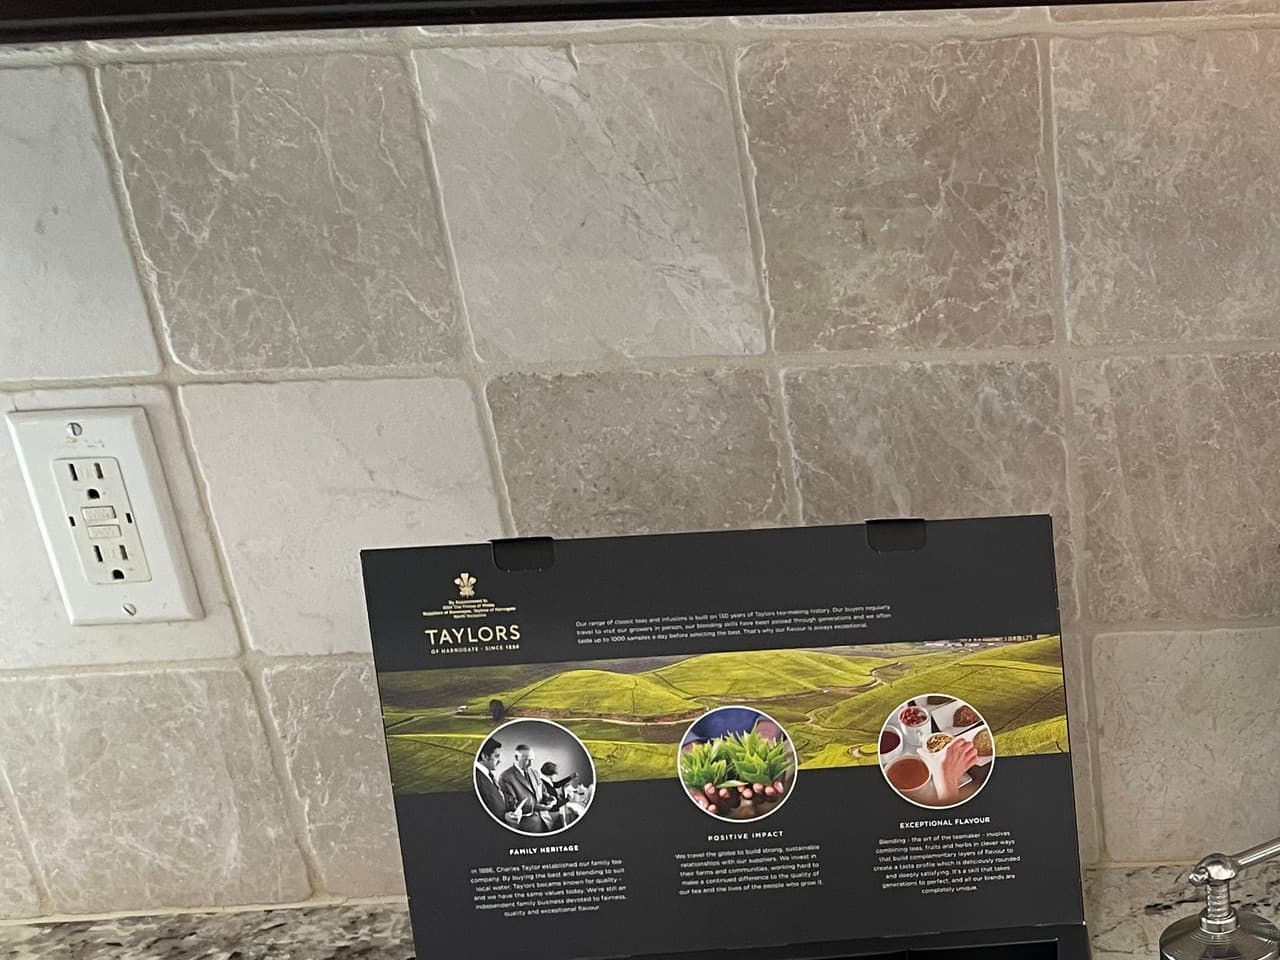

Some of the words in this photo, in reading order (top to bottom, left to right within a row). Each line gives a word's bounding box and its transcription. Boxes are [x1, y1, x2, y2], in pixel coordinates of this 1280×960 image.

[425, 624, 521, 645] TAYLORS
[900, 819, 952, 829] EXCEPTIONAL
[955, 816, 991, 825] FLAVOUR
[708, 833, 749, 841] POSITIVE
[752, 830, 784, 838] IMPACT
[510, 847, 538, 856] FAMILY
[540, 845, 579, 853] HERITAGE
